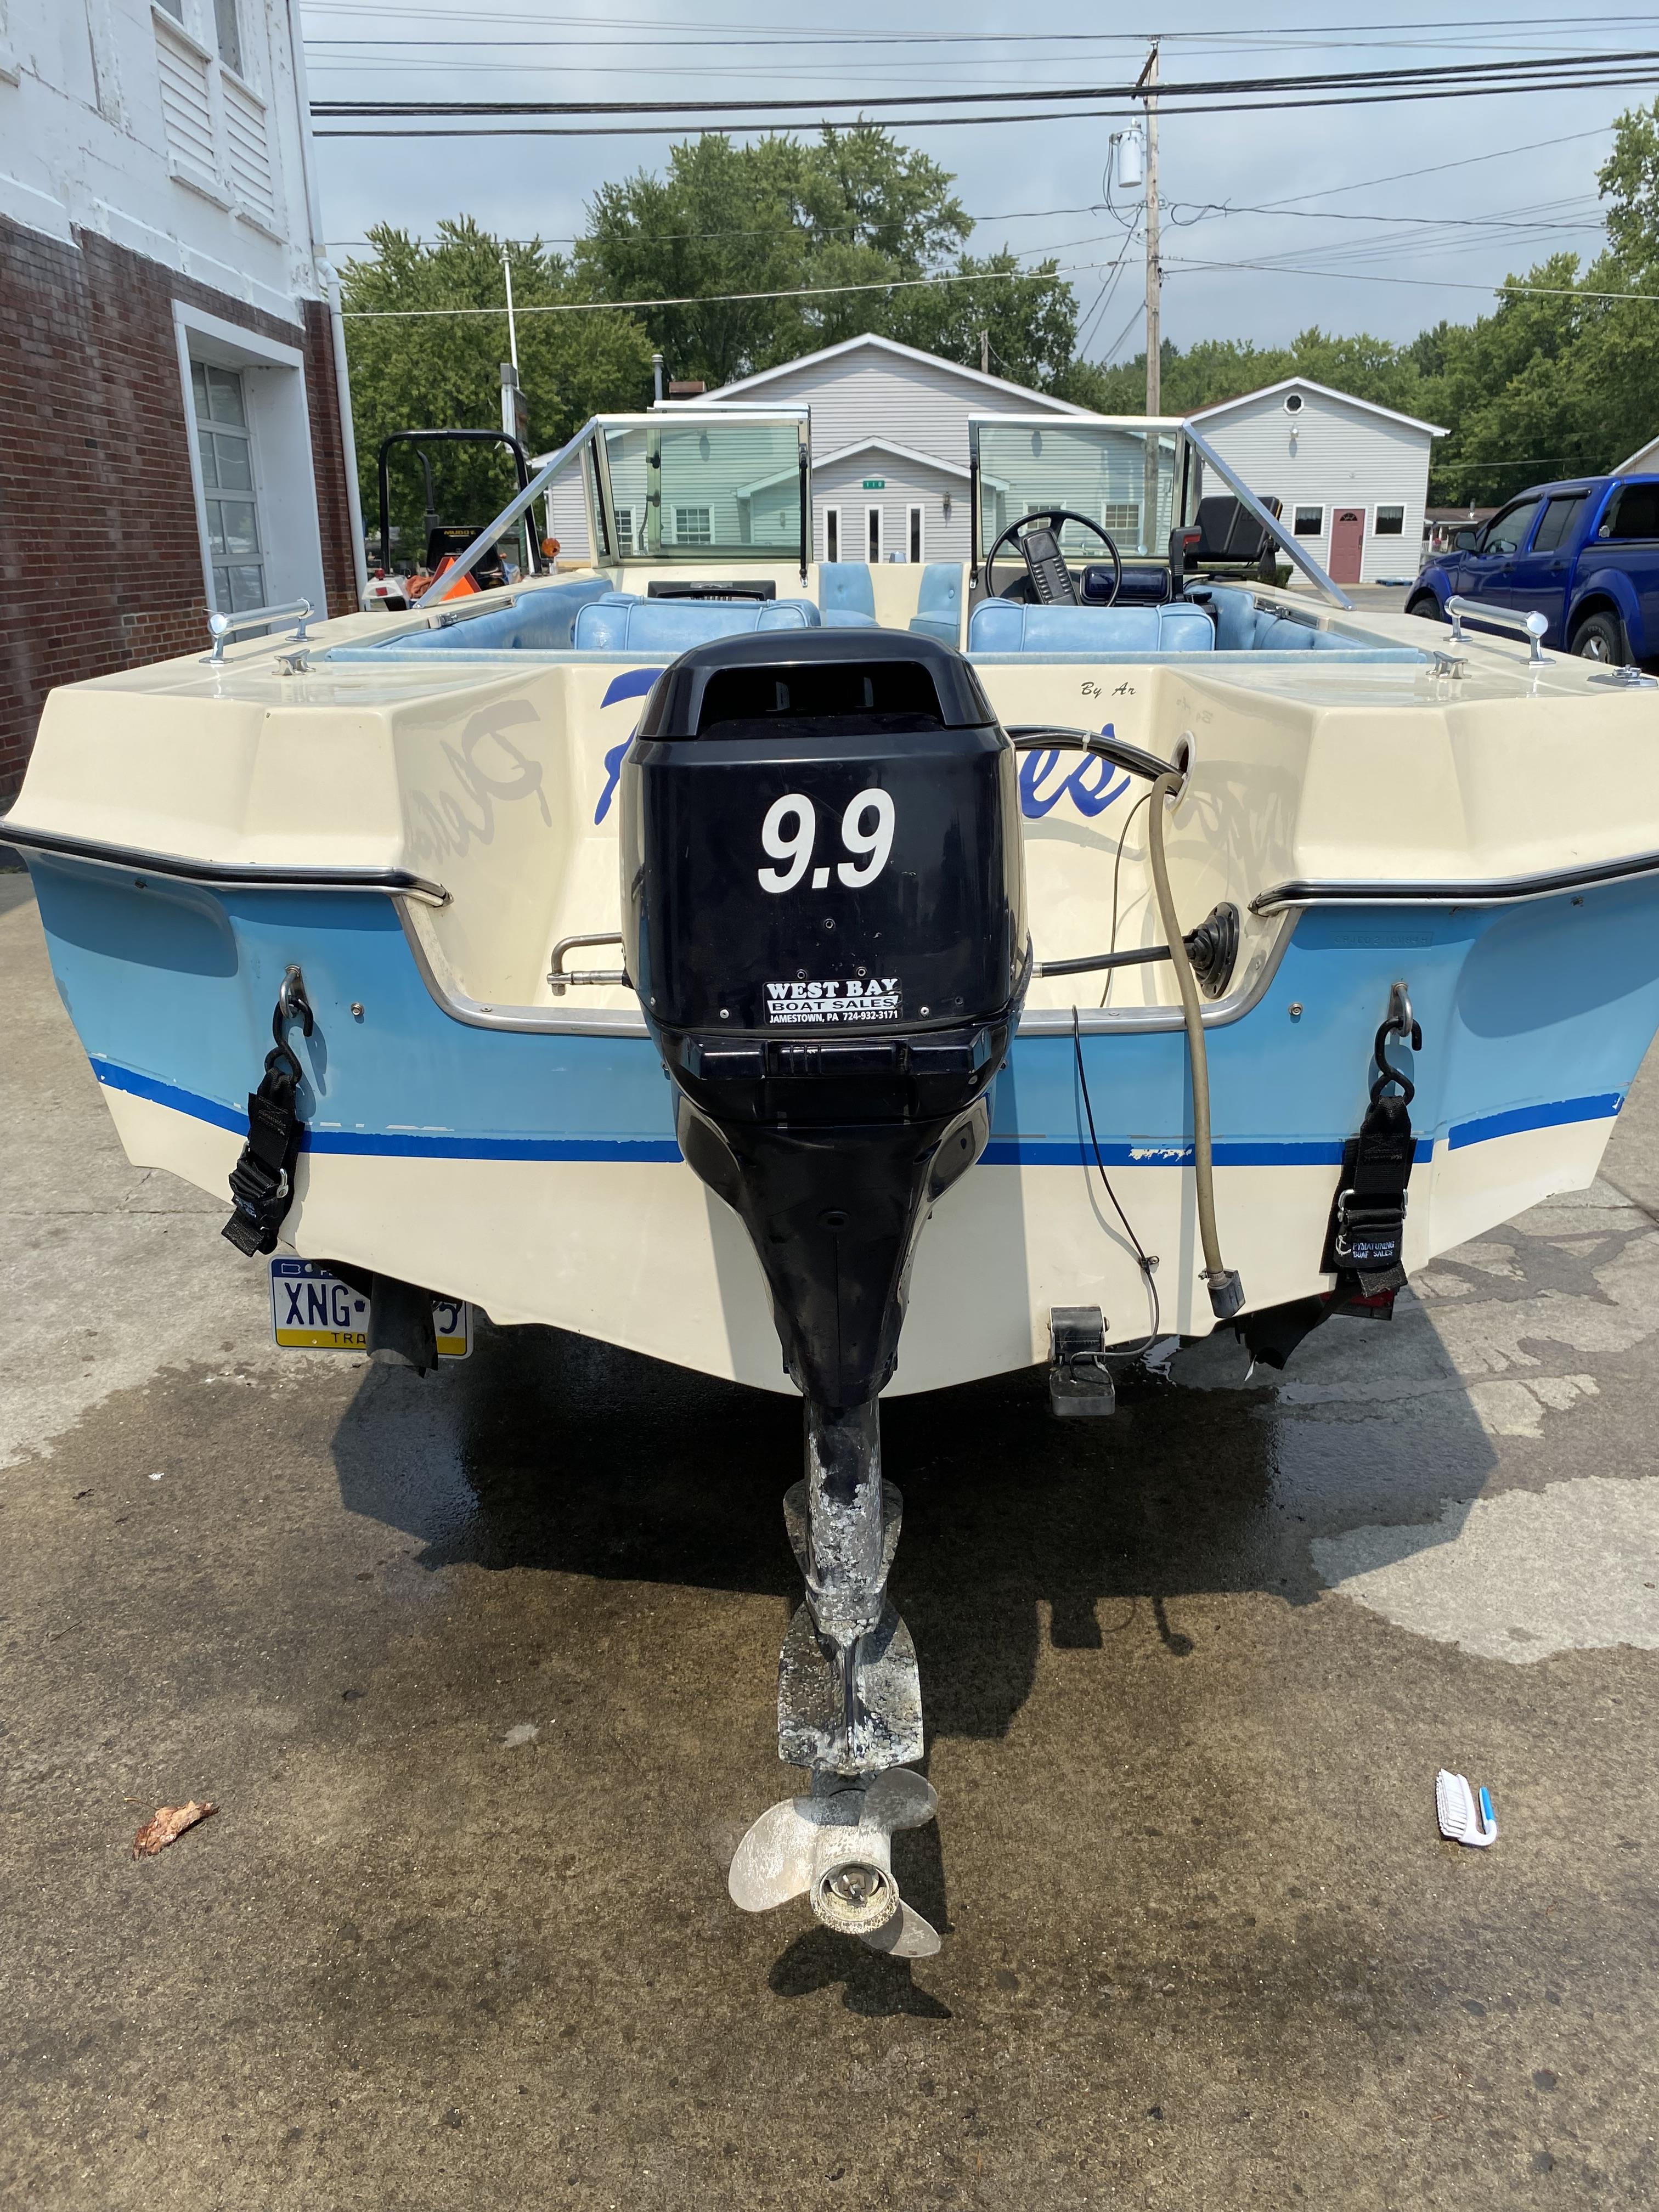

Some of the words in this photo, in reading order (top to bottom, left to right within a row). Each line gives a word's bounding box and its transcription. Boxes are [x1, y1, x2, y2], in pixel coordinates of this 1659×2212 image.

[1081, 681, 1102, 699] By
[758, 788, 895, 893] 9.9
[766, 981, 839, 999] WEST
[846, 978, 898, 996] BAY
[772, 1002, 825, 1012] BOAT
[832, 999, 895, 1009] SALES
[770, 1013, 825, 1023] JAMESTOWN,
[827, 1013, 839, 1022] PA
[843, 1011, 898, 1021] 724-932-3171
[284, 1282, 350, 1327] XNG
